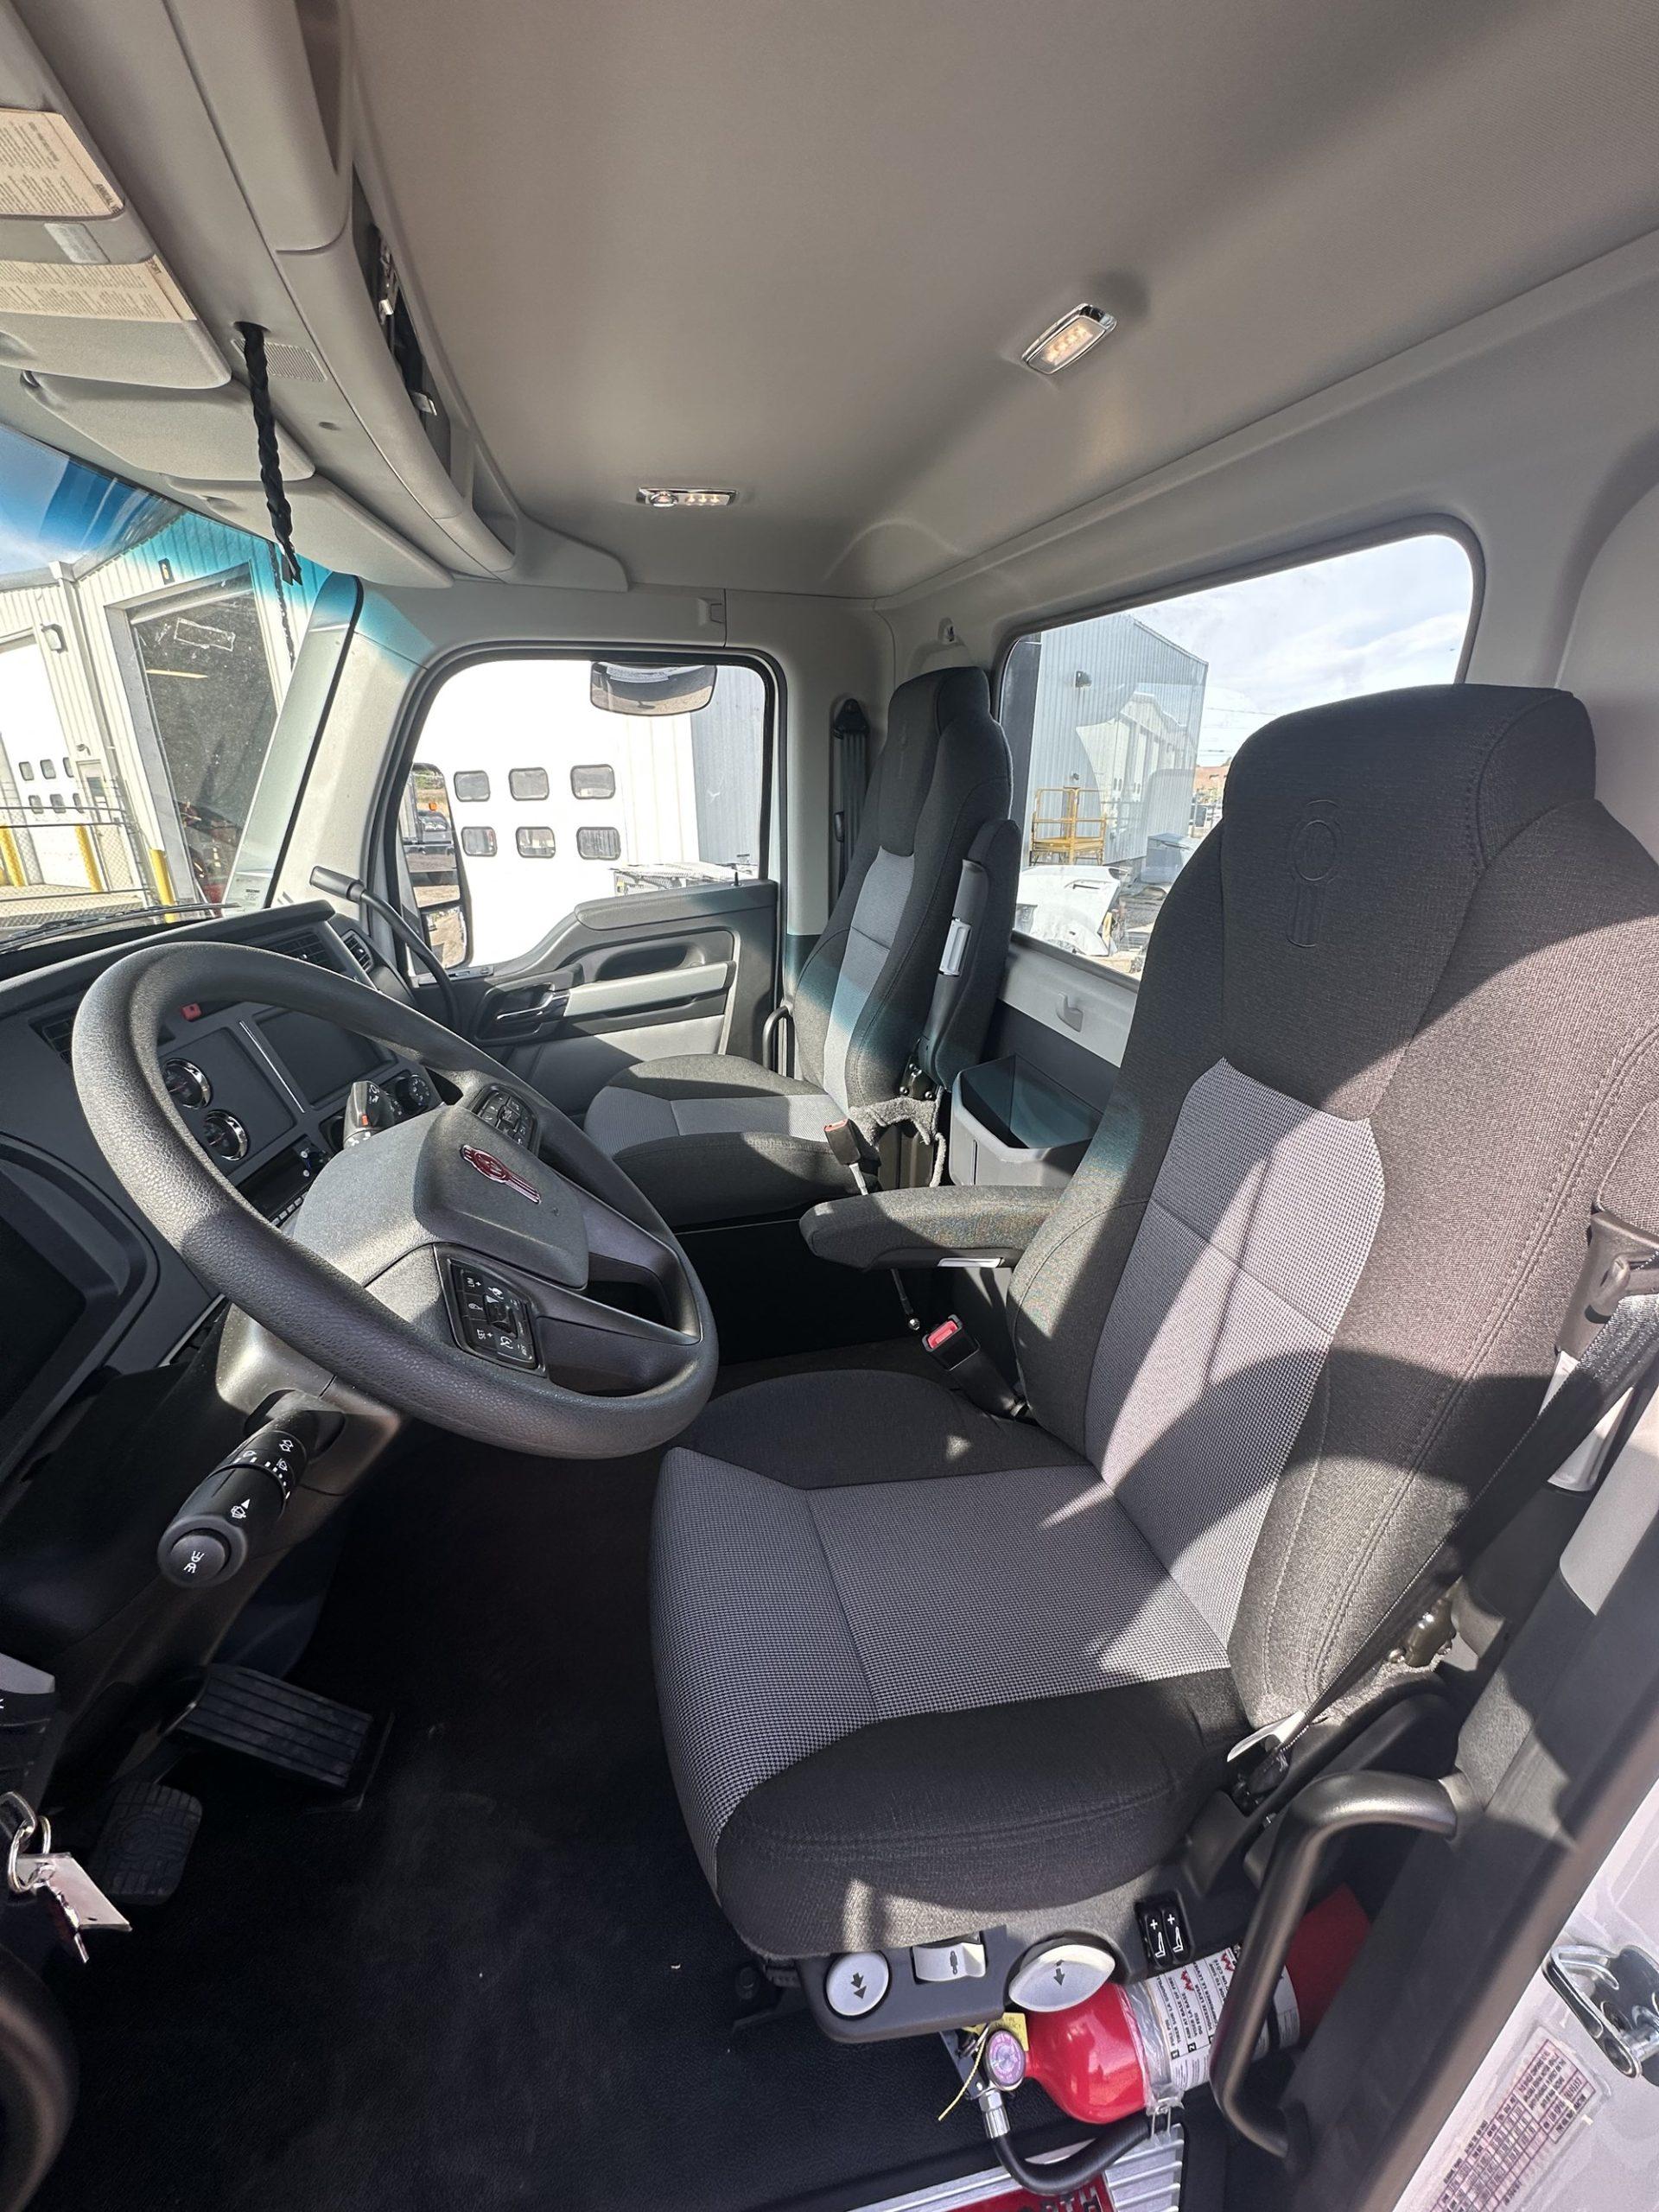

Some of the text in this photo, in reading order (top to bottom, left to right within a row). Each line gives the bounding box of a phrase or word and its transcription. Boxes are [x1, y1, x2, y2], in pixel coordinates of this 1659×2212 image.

[1214, 1977, 1220, 1986] TO
[1194, 1984, 1204, 2002] LEVER
[1186, 2009, 1192, 2018] LA
[1201, 2003, 1212, 2030] SQUEEZE
